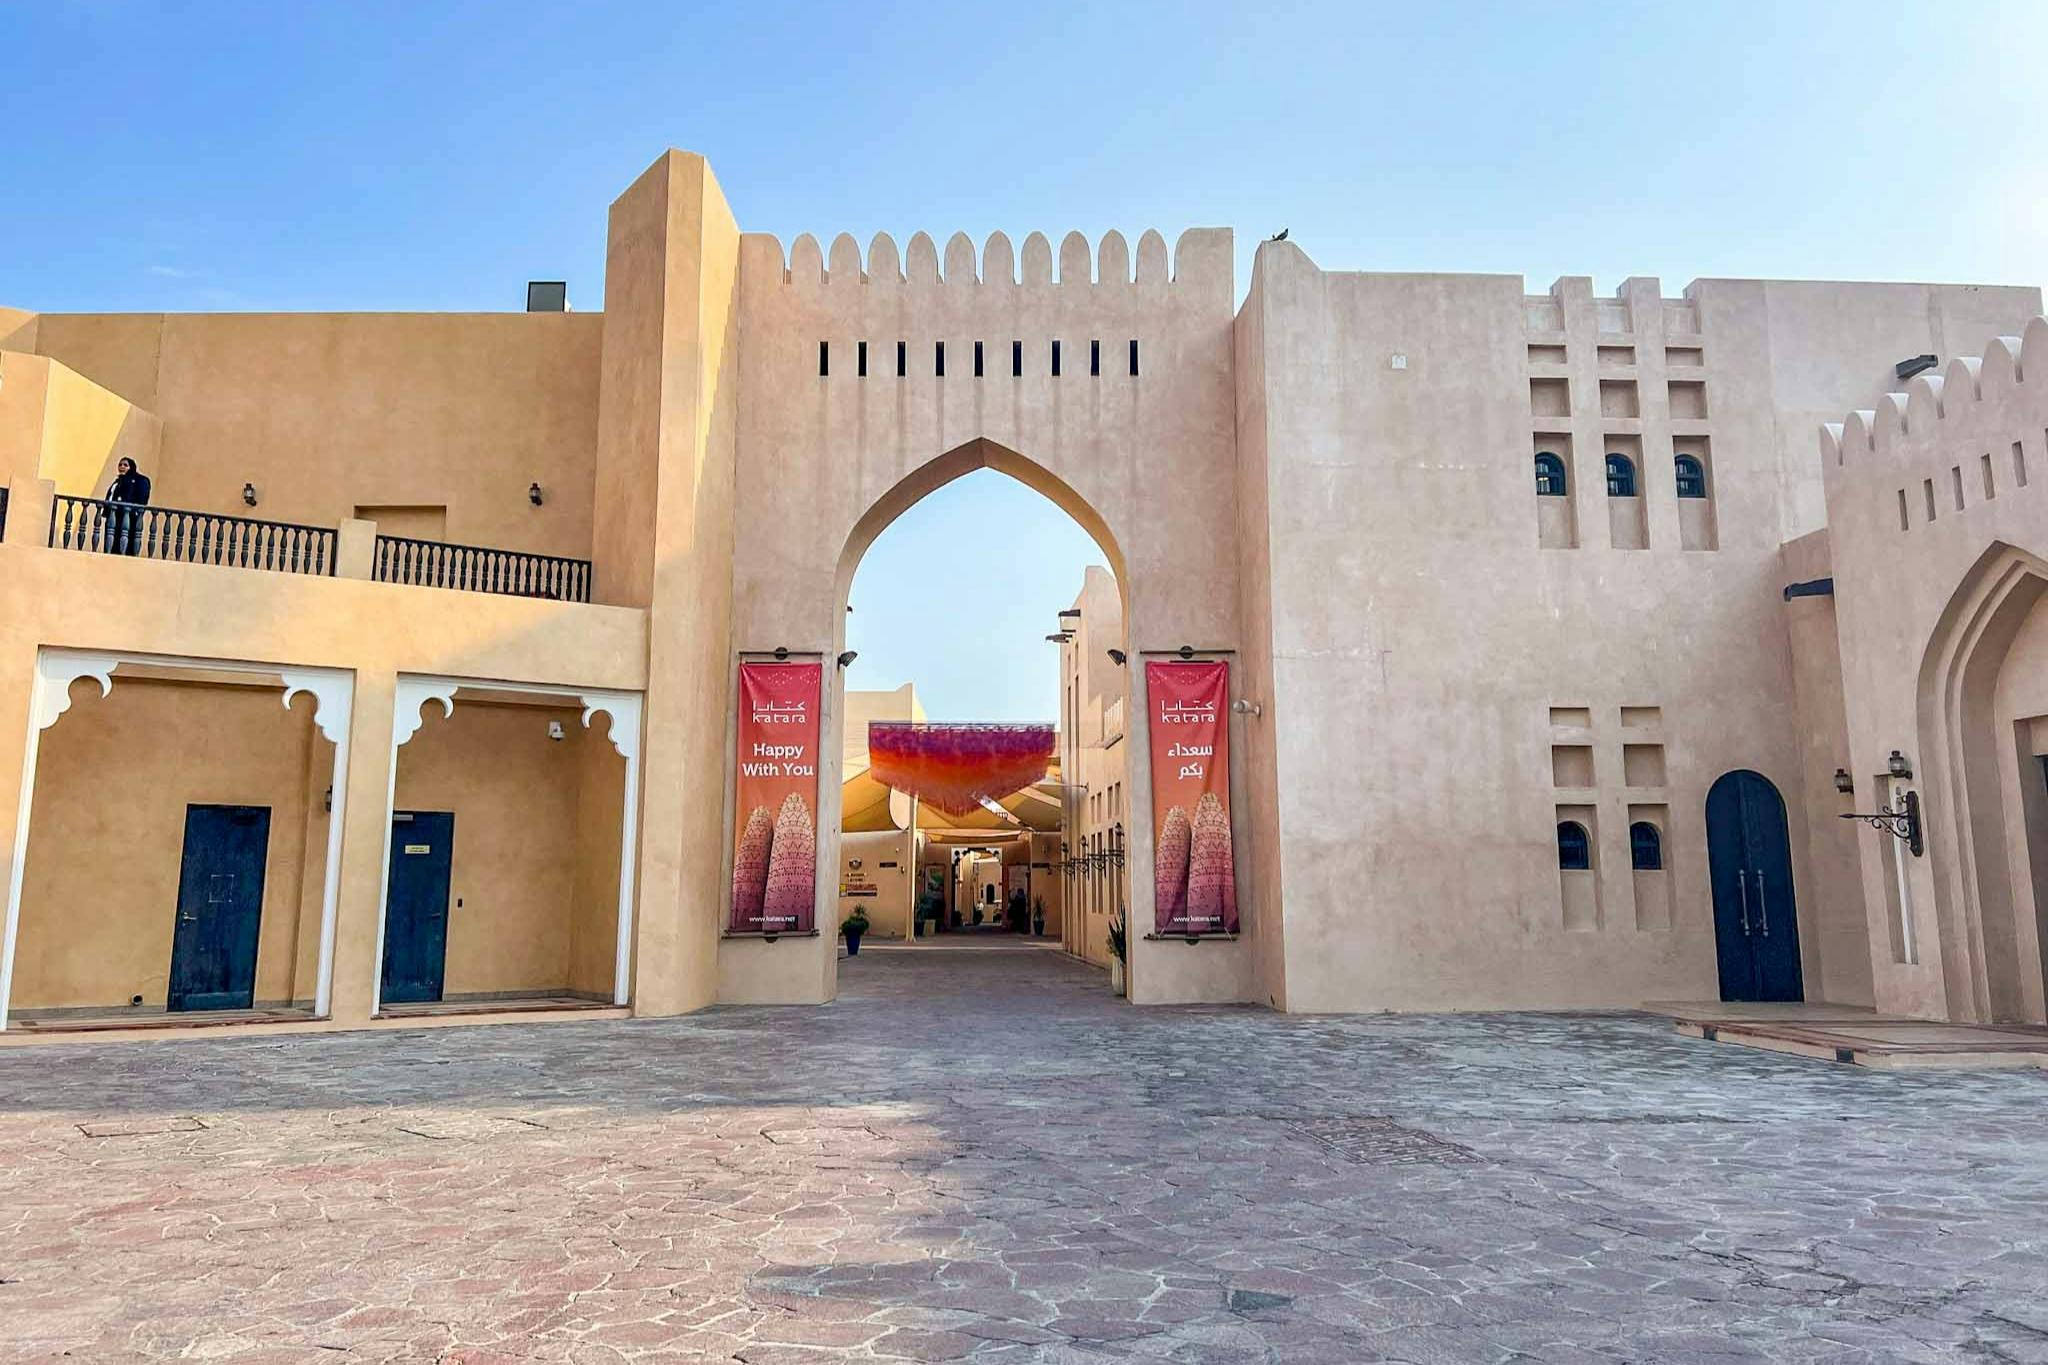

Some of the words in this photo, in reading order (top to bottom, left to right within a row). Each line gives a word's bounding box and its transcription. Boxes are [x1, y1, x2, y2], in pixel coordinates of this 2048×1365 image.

[752, 712, 806, 724] katara
[1161, 712, 1215, 724] katara
[753, 743, 804, 759] Happy
[1167, 742, 1213, 757] سعداء
[742, 762, 779, 777] With
[782, 762, 814, 777] You
[1178, 762, 1203, 780] بكم
